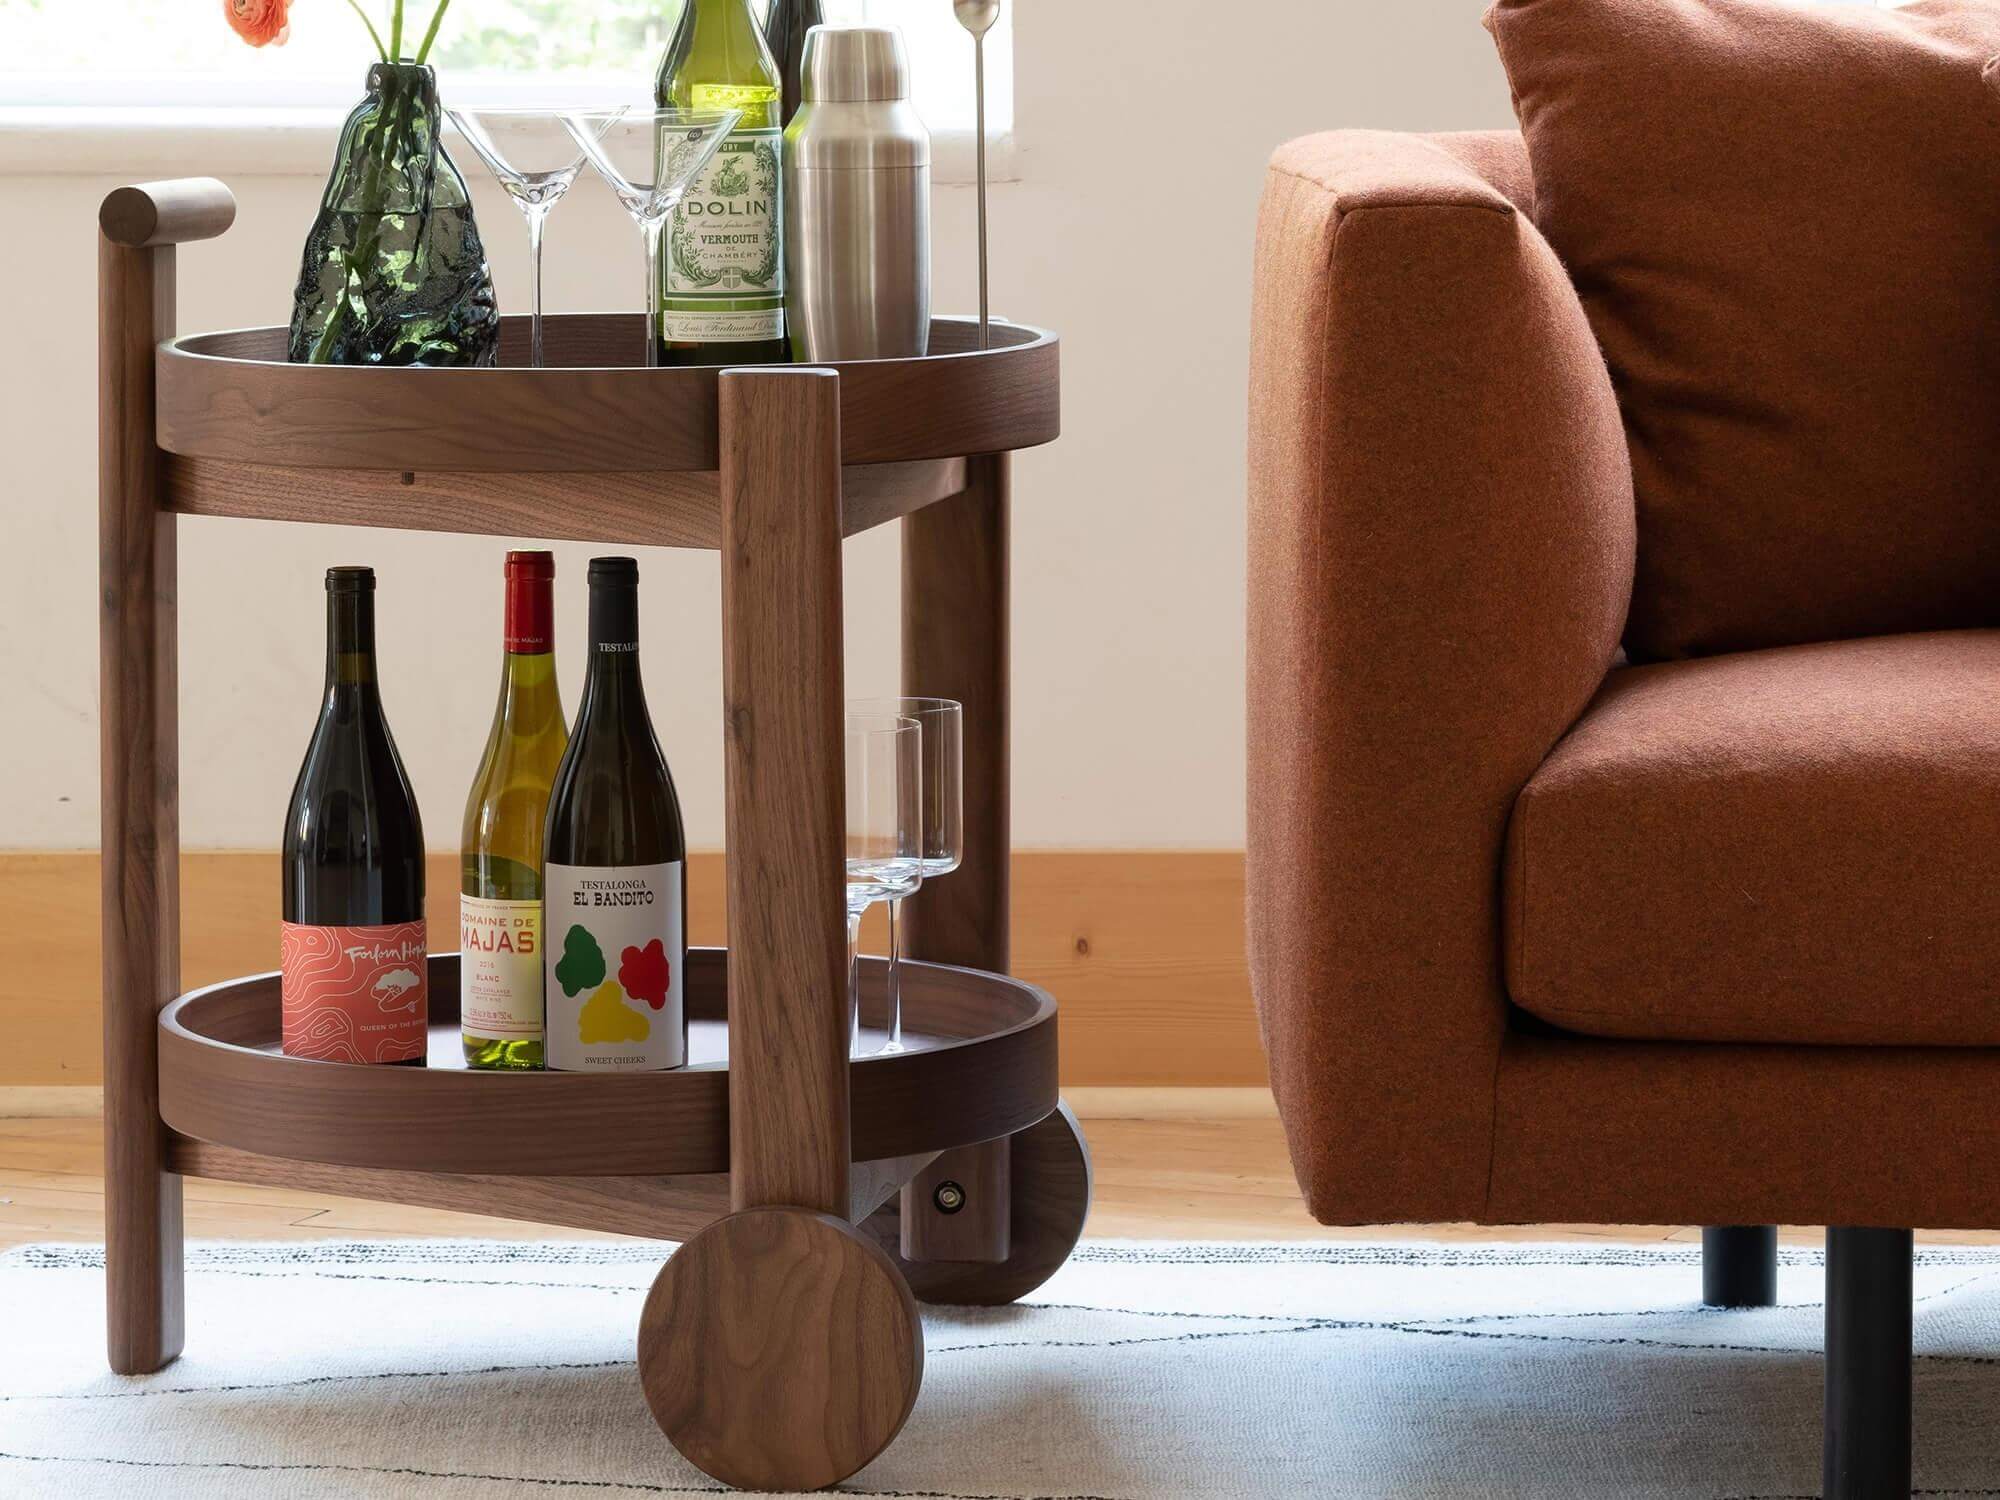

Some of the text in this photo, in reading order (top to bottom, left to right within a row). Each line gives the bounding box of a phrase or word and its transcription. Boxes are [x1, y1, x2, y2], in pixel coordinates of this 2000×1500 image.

[688, 200, 767, 215] DOLIN
[700, 233, 759, 245] VERMOUTH
[580, 879, 646, 890] TESTALONGA
[573, 890, 655, 907] EL BANDITO
[513, 918, 535, 928] DE
[462, 927, 535, 954] MAJAS
[475, 973, 500, 983] BLANC
[360, 1024, 386, 1032] QUEEN
[584, 1055, 646, 1065] SWEET CHEEKS
